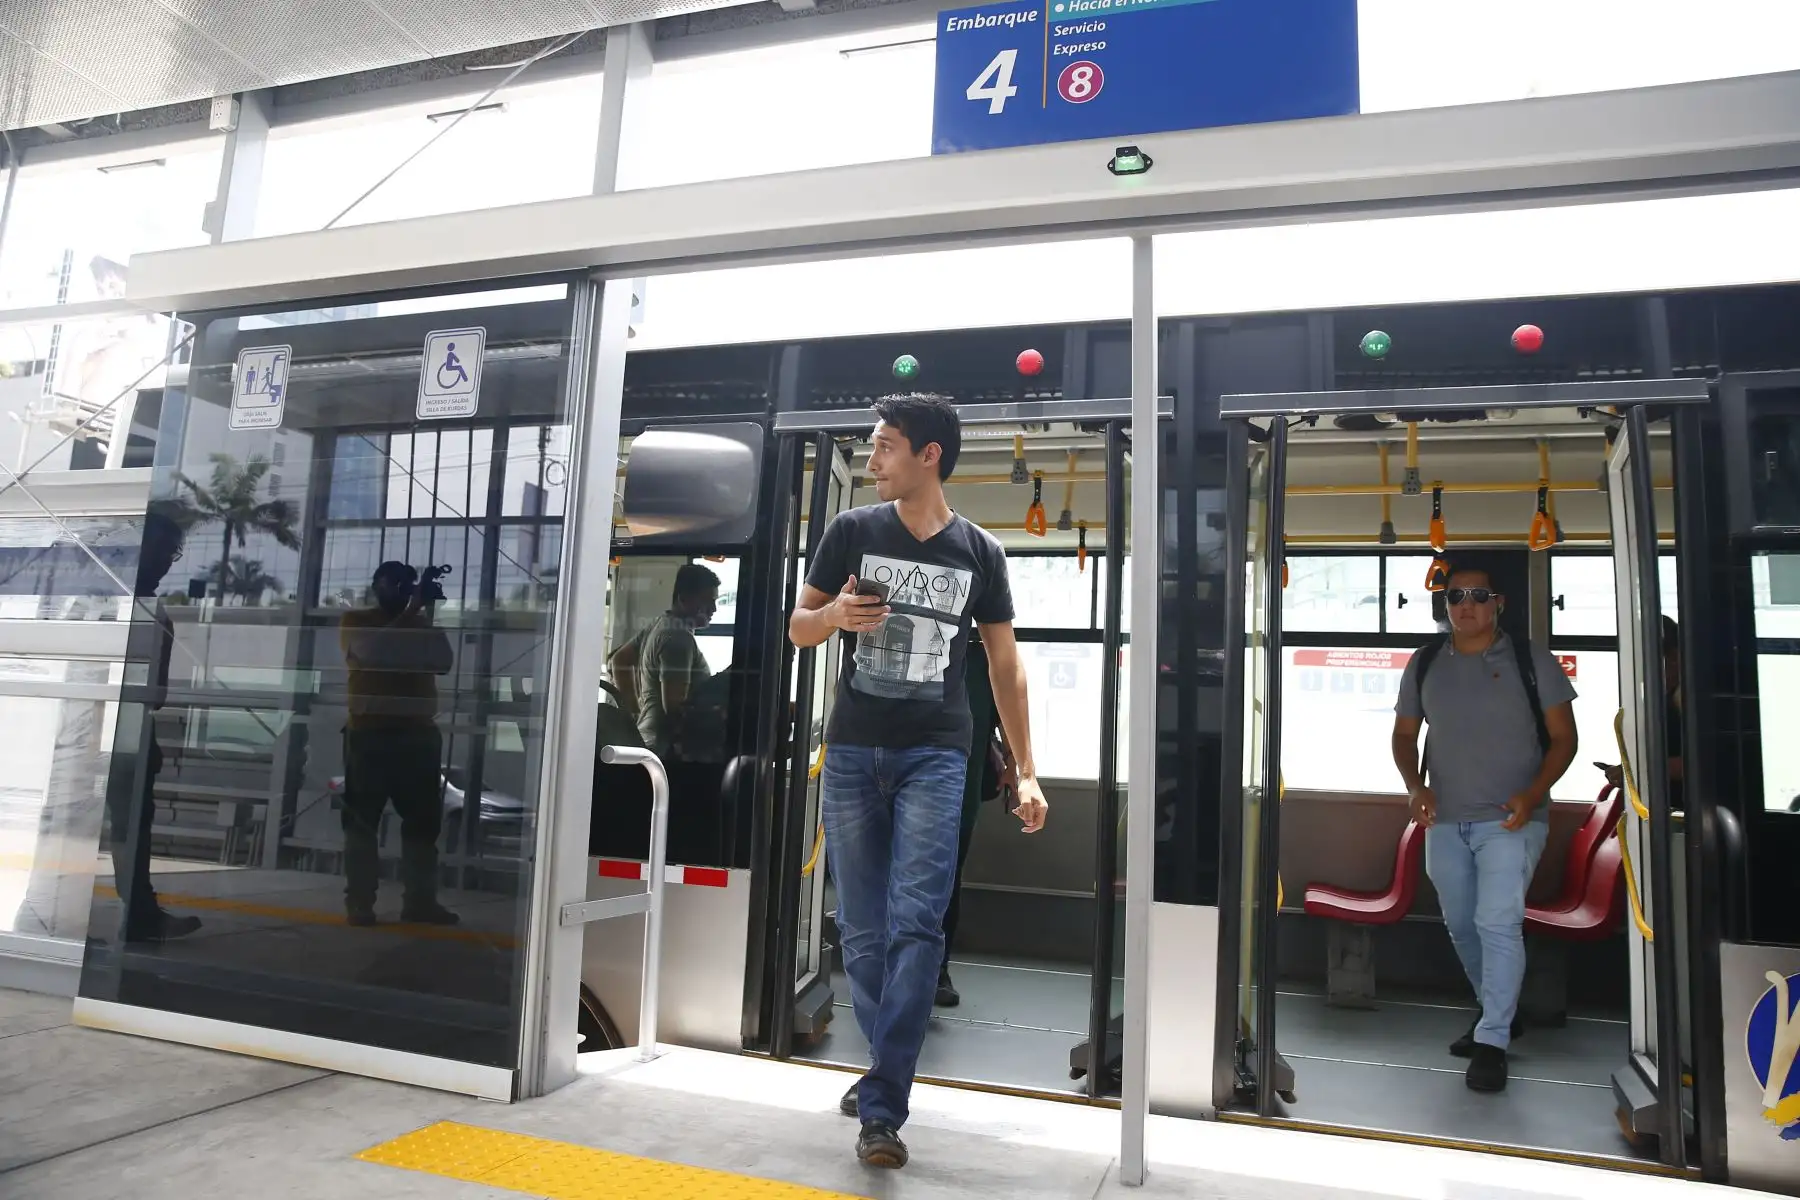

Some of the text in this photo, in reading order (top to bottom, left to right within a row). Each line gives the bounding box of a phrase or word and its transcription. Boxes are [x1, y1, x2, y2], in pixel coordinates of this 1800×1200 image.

[1069, 0, 1111, 13] Hacia
[946, 10, 1038, 32] Embarque
[1053, 21, 1106, 37] Servicio
[1053, 41, 1106, 56] Expreso
[966, 49, 1018, 115] 4
[1068, 66, 1093, 98] 8
[864, 564, 968, 598] LONDON
